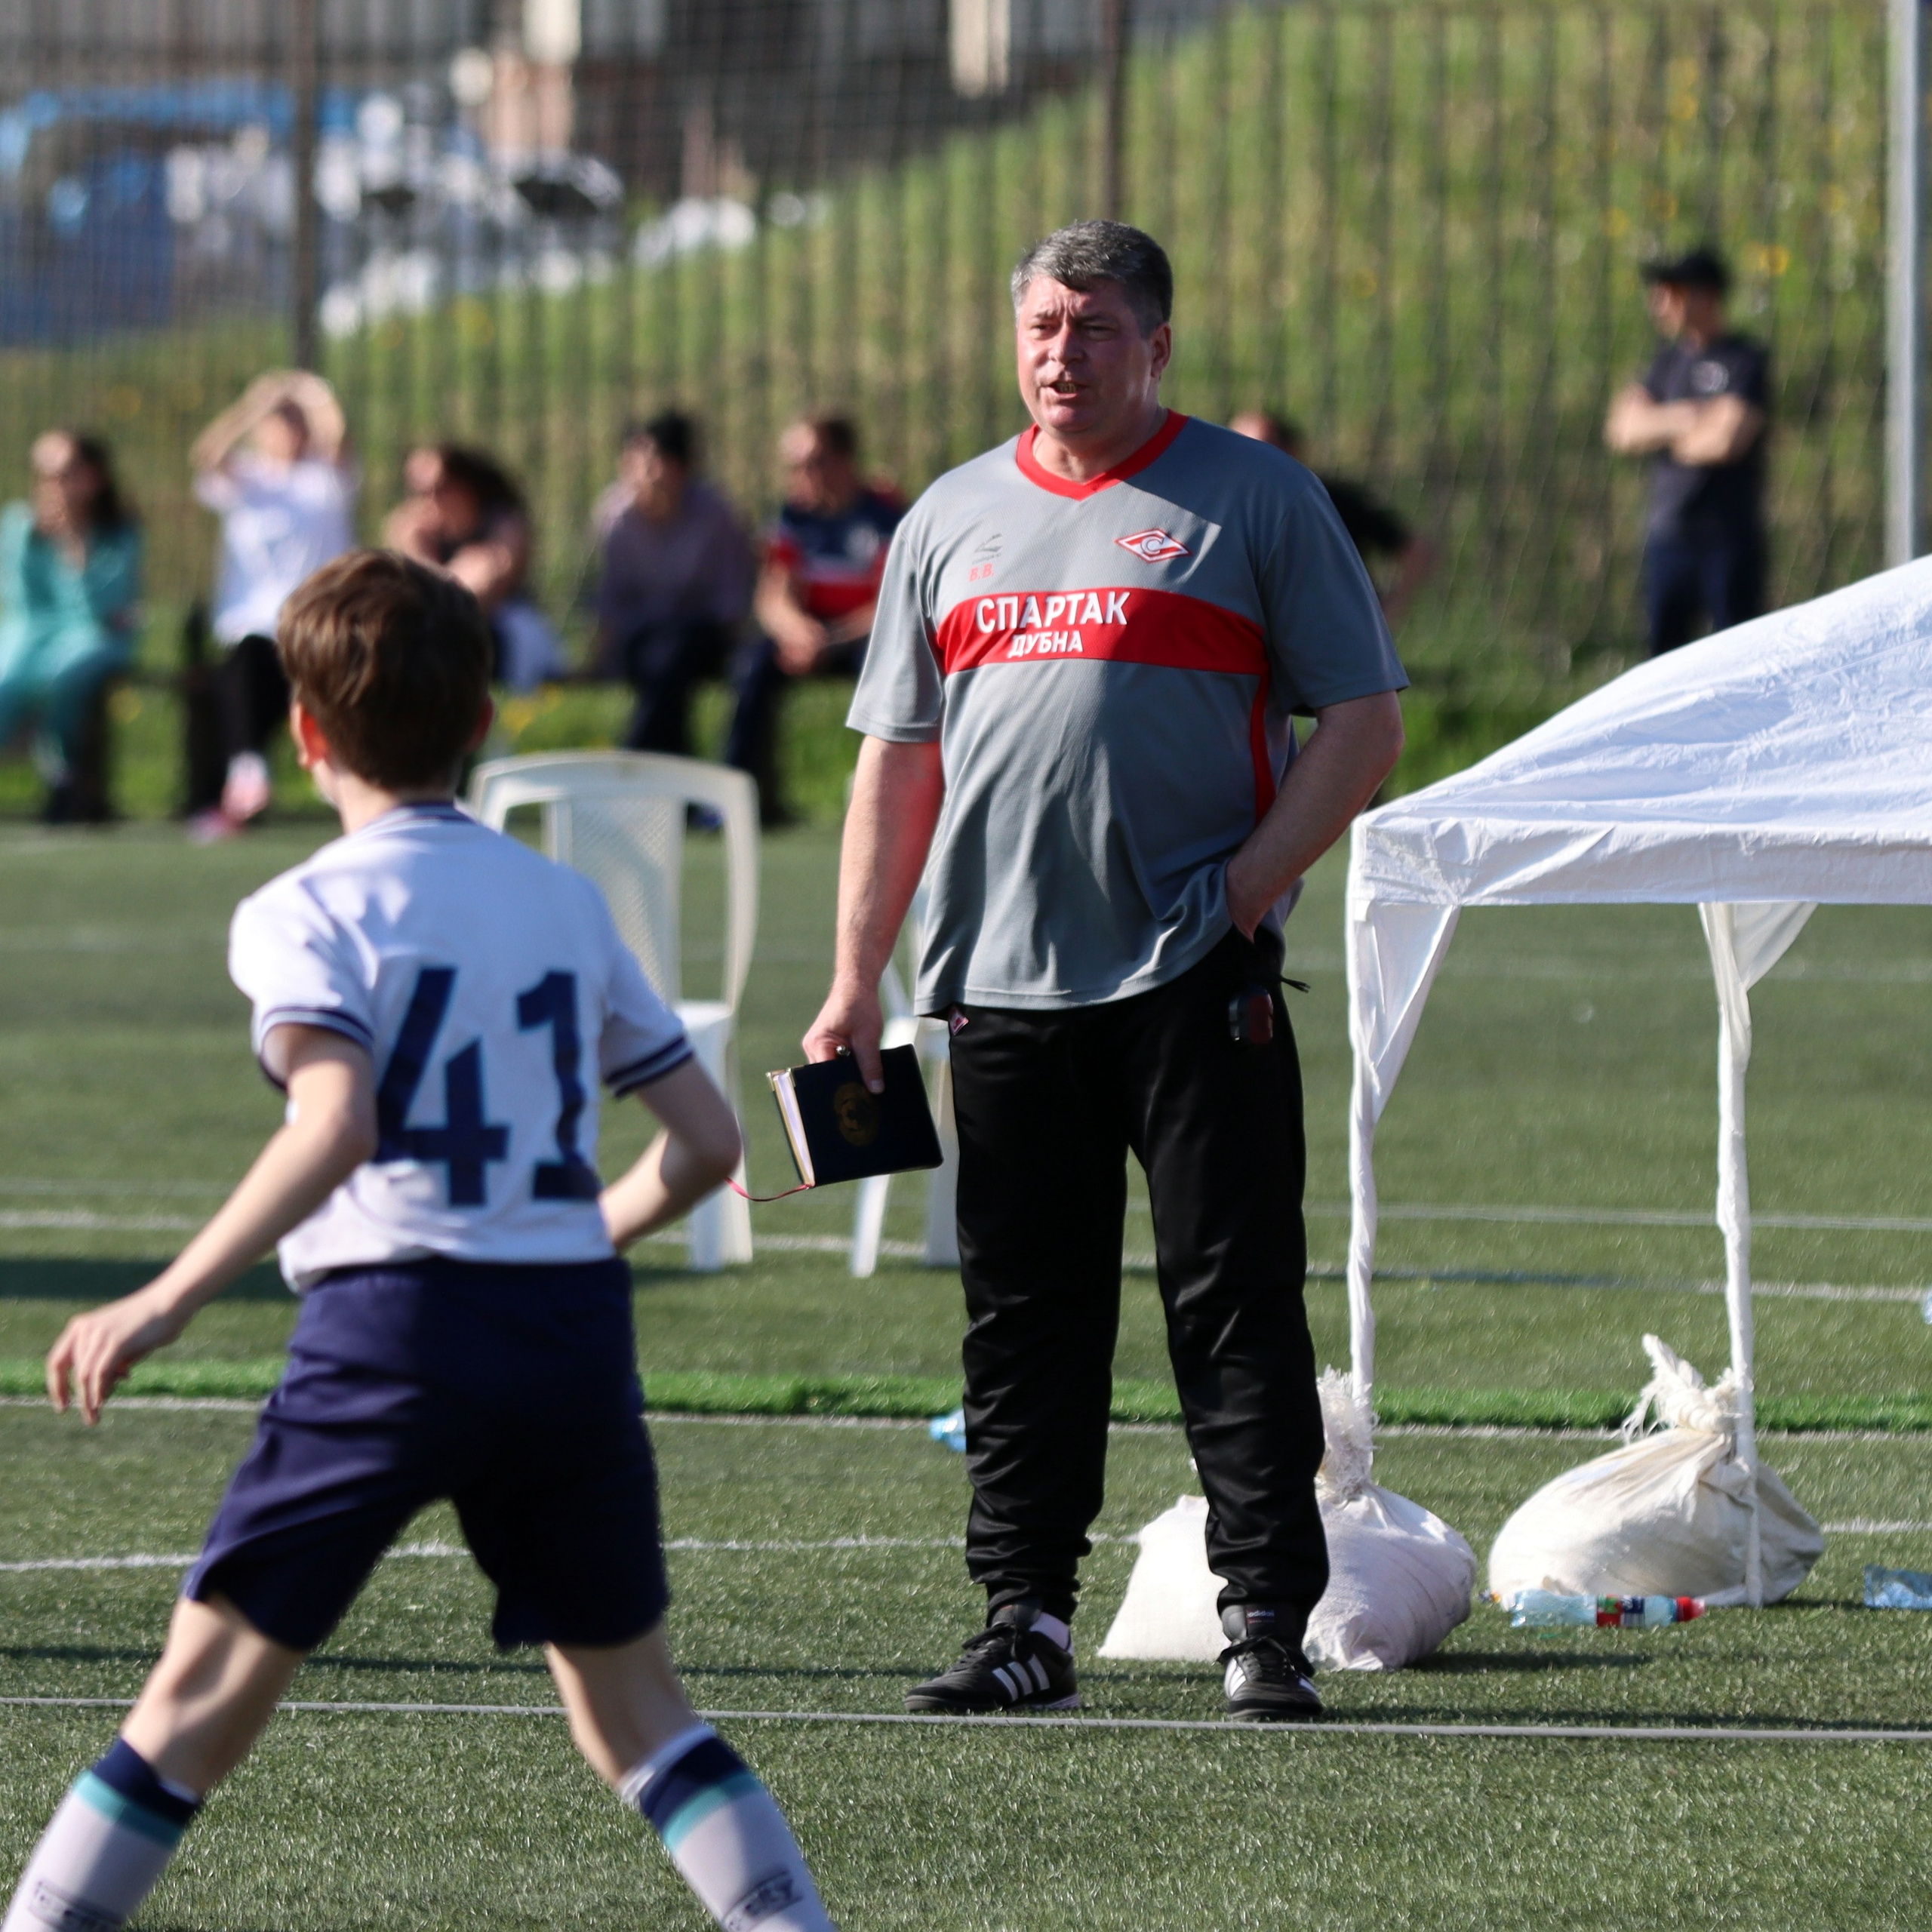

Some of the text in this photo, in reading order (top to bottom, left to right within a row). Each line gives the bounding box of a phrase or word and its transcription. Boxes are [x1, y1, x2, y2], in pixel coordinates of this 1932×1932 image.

[977, 592, 1131, 632] СПАРТАК
[1008, 632, 1083, 658] ДУБНА
[374, 966, 602, 1206] 41
